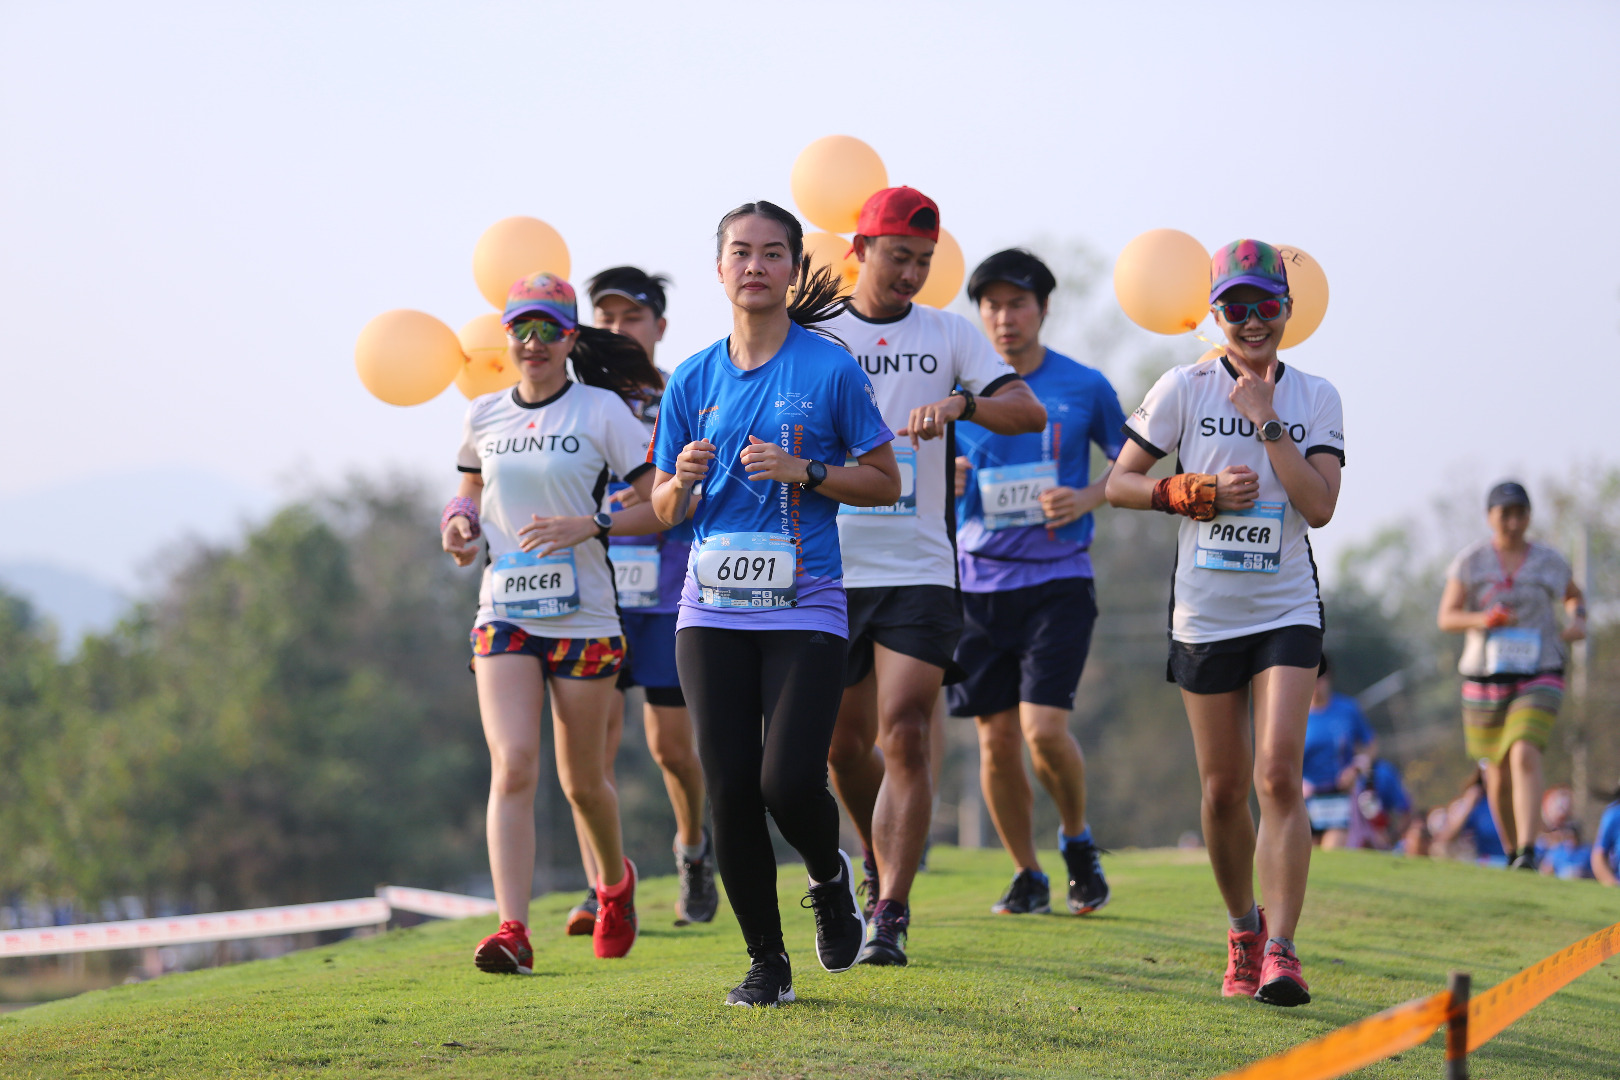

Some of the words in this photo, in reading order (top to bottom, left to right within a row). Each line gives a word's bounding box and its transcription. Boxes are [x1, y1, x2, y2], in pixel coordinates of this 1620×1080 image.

[774, 400, 785, 408] SP
[801, 401, 813, 409] XC
[1201, 417, 1306, 443] SUUO
[484, 436, 580, 458] SUUNTO
[1209, 523, 1271, 544] PACER
[717, 556, 776, 581] 6091
[505, 573, 561, 593] PACER
